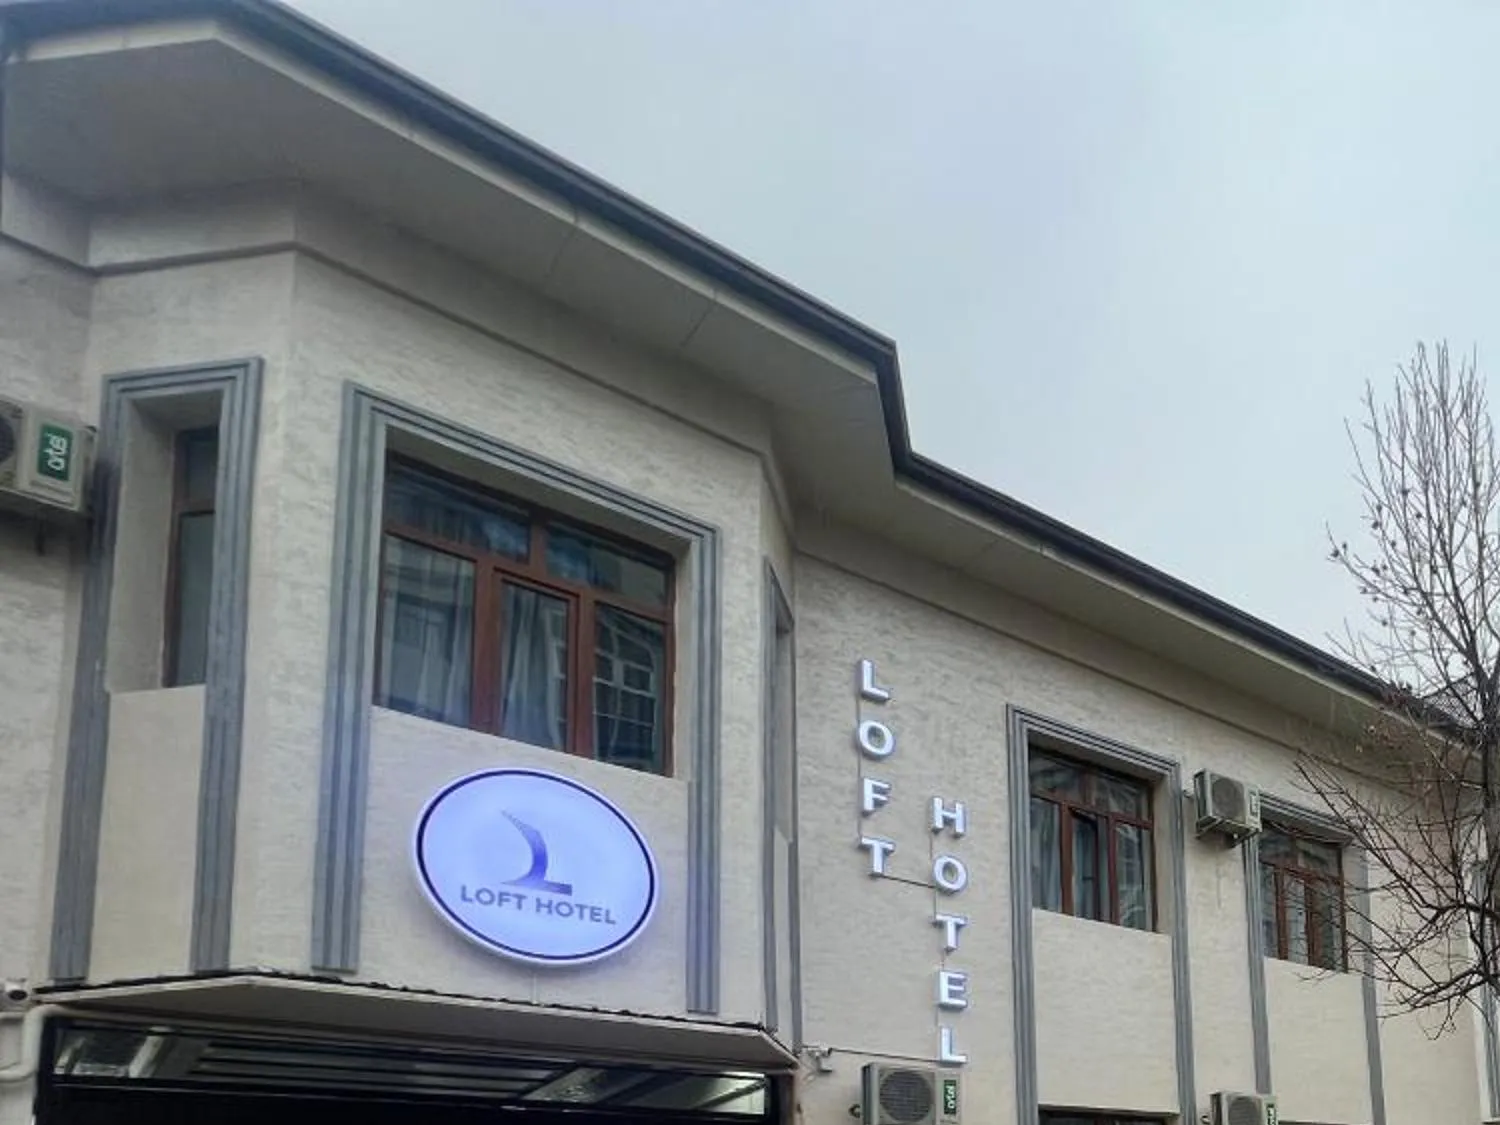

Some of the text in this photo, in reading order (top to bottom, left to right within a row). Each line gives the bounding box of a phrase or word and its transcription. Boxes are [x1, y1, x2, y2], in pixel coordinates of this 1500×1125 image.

[856, 658, 895, 877] LOFT
[460, 885, 616, 925] LOFT HOTEL
[931, 796, 968, 1065] HOTEL
